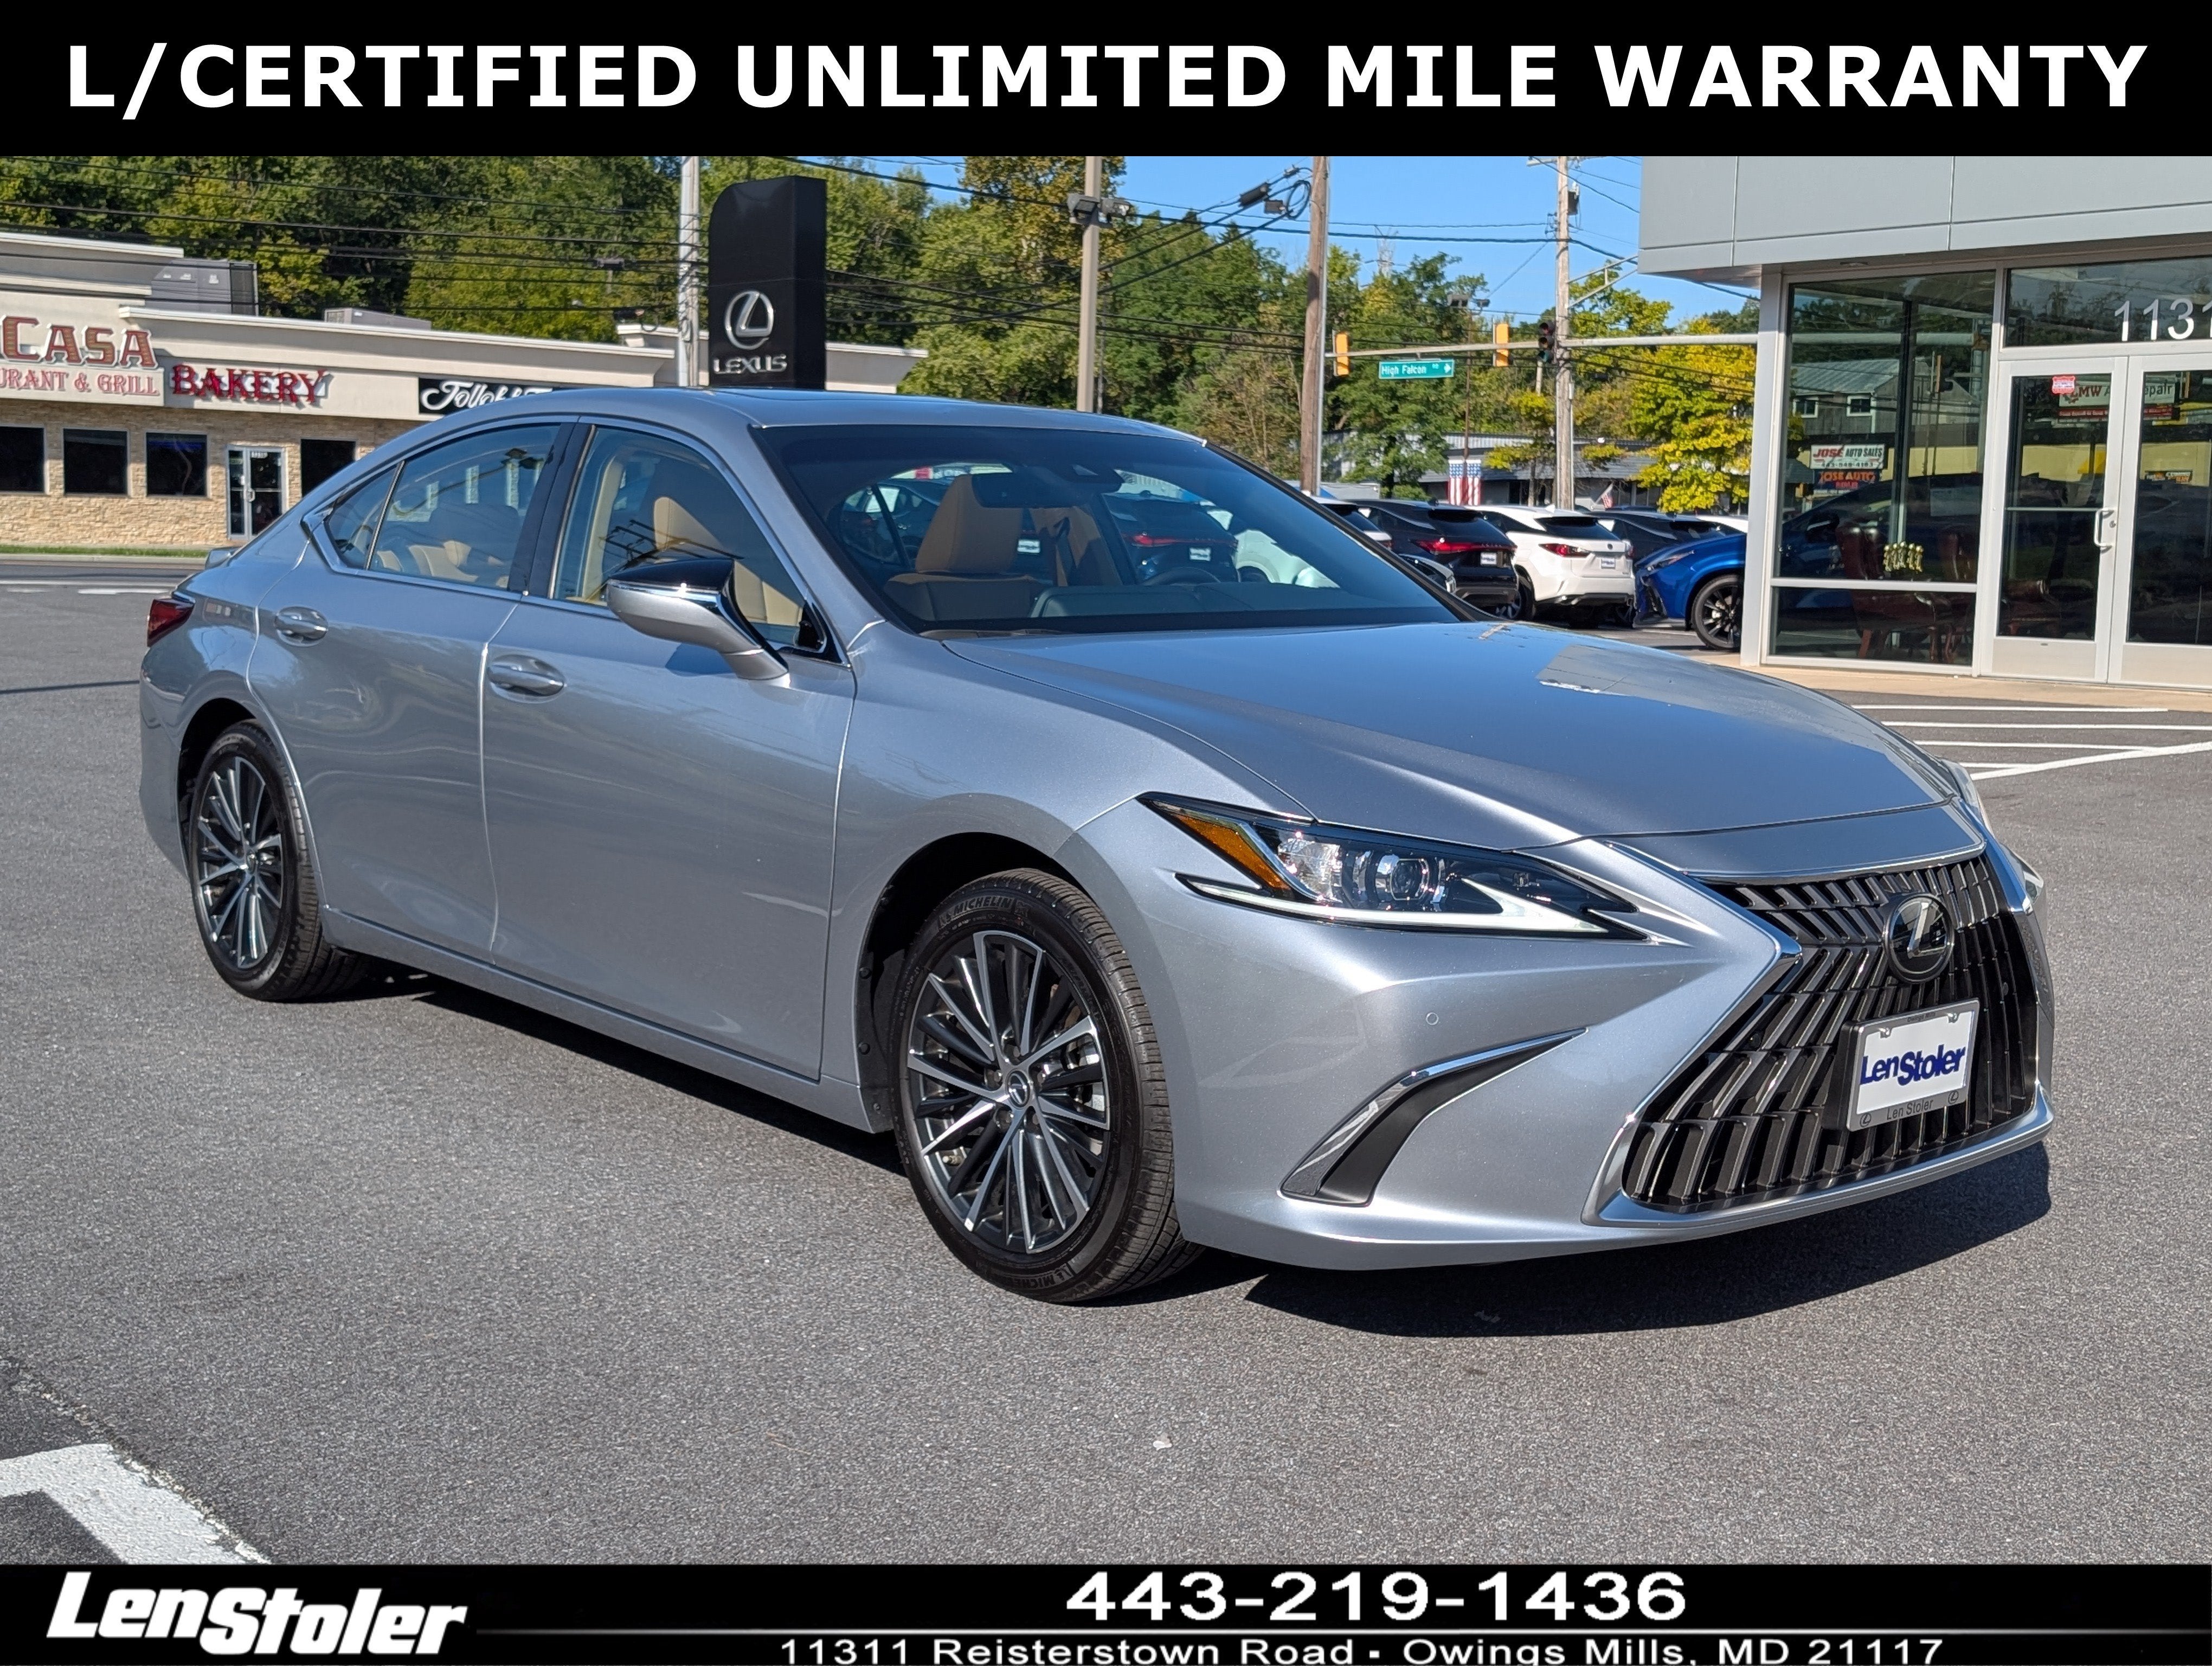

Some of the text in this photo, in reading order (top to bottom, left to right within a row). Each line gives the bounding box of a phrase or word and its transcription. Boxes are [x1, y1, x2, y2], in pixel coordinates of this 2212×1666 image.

[1, 315, 158, 370] CASA
[713, 354, 788, 374] LEXUS
[1381, 365, 1399, 377] High
[1401, 364, 1427, 374] Falcon
[74, 372, 91, 393] &
[97, 374, 160, 396] GRILL
[172, 363, 329, 403] BAKERY
[2144, 380, 2172, 397] epair
[1813, 447, 1883, 458] JOSE AUTO SALES
[1845, 471, 1876, 483] AUTO
[953, 895, 1013, 915] MICHELIN
[1860, 1045, 1966, 1086] LenStoler
[1887, 1099, 1933, 1120] Len Stoler
